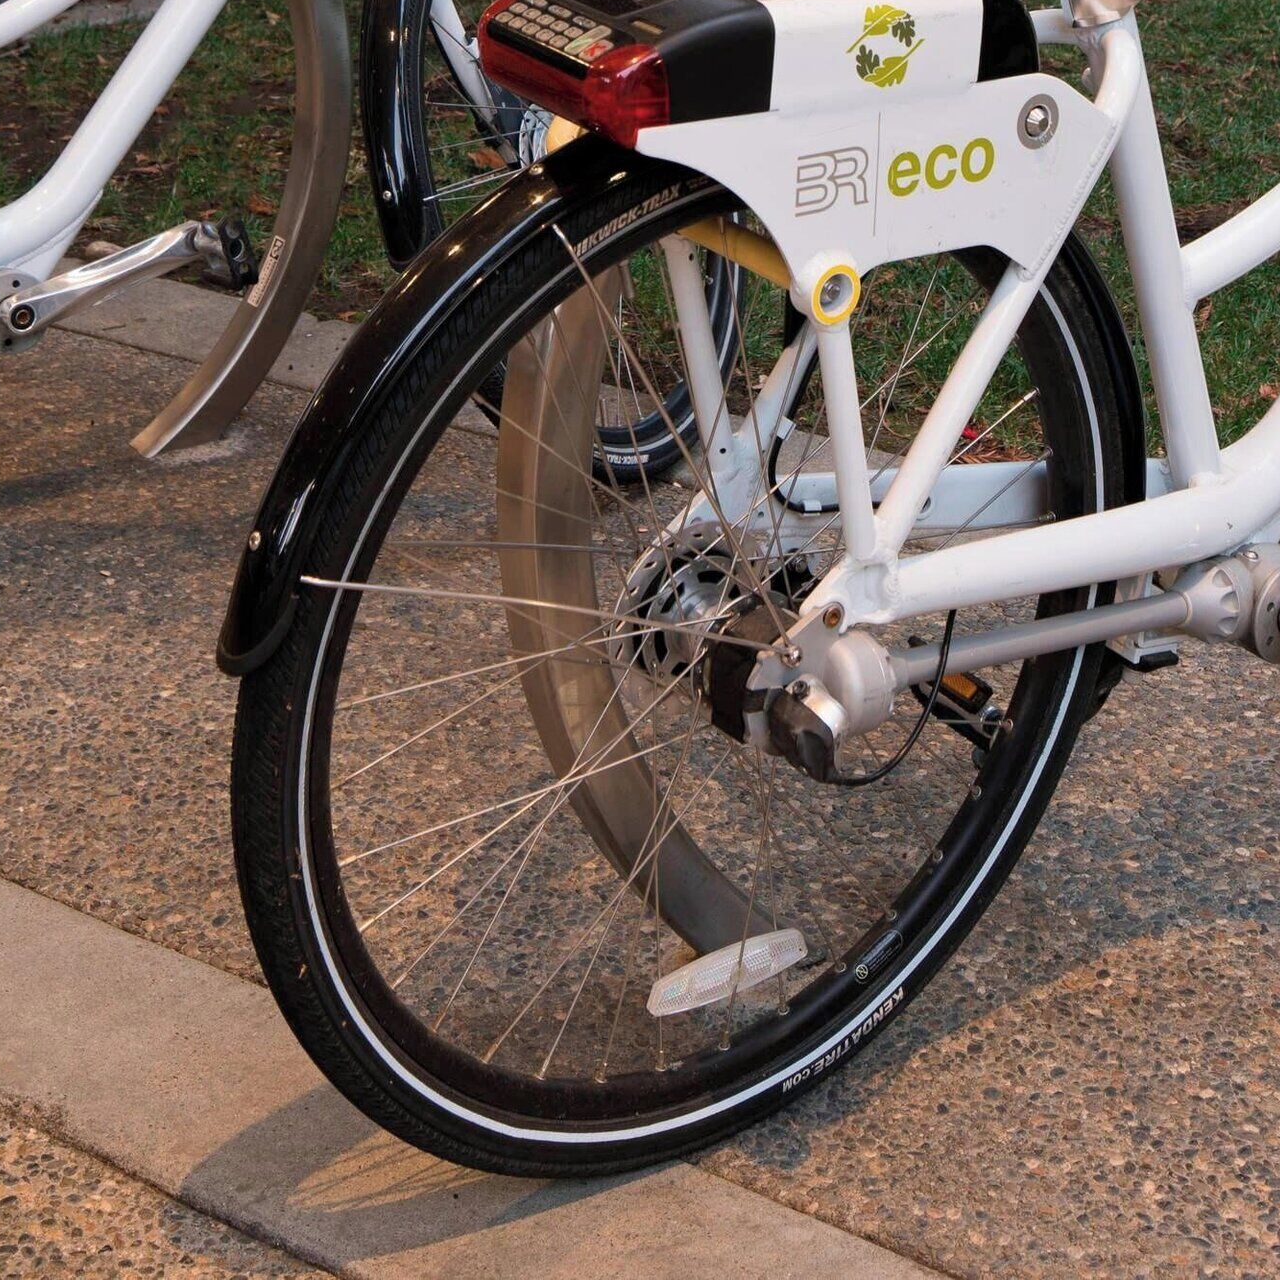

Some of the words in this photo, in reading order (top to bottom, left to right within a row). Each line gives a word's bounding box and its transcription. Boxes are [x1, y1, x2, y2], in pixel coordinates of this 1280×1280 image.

[795, 146, 869, 218] BR
[887, 137, 995, 197] eco
[782, 986, 905, 1093] KENDATIRE.COM
